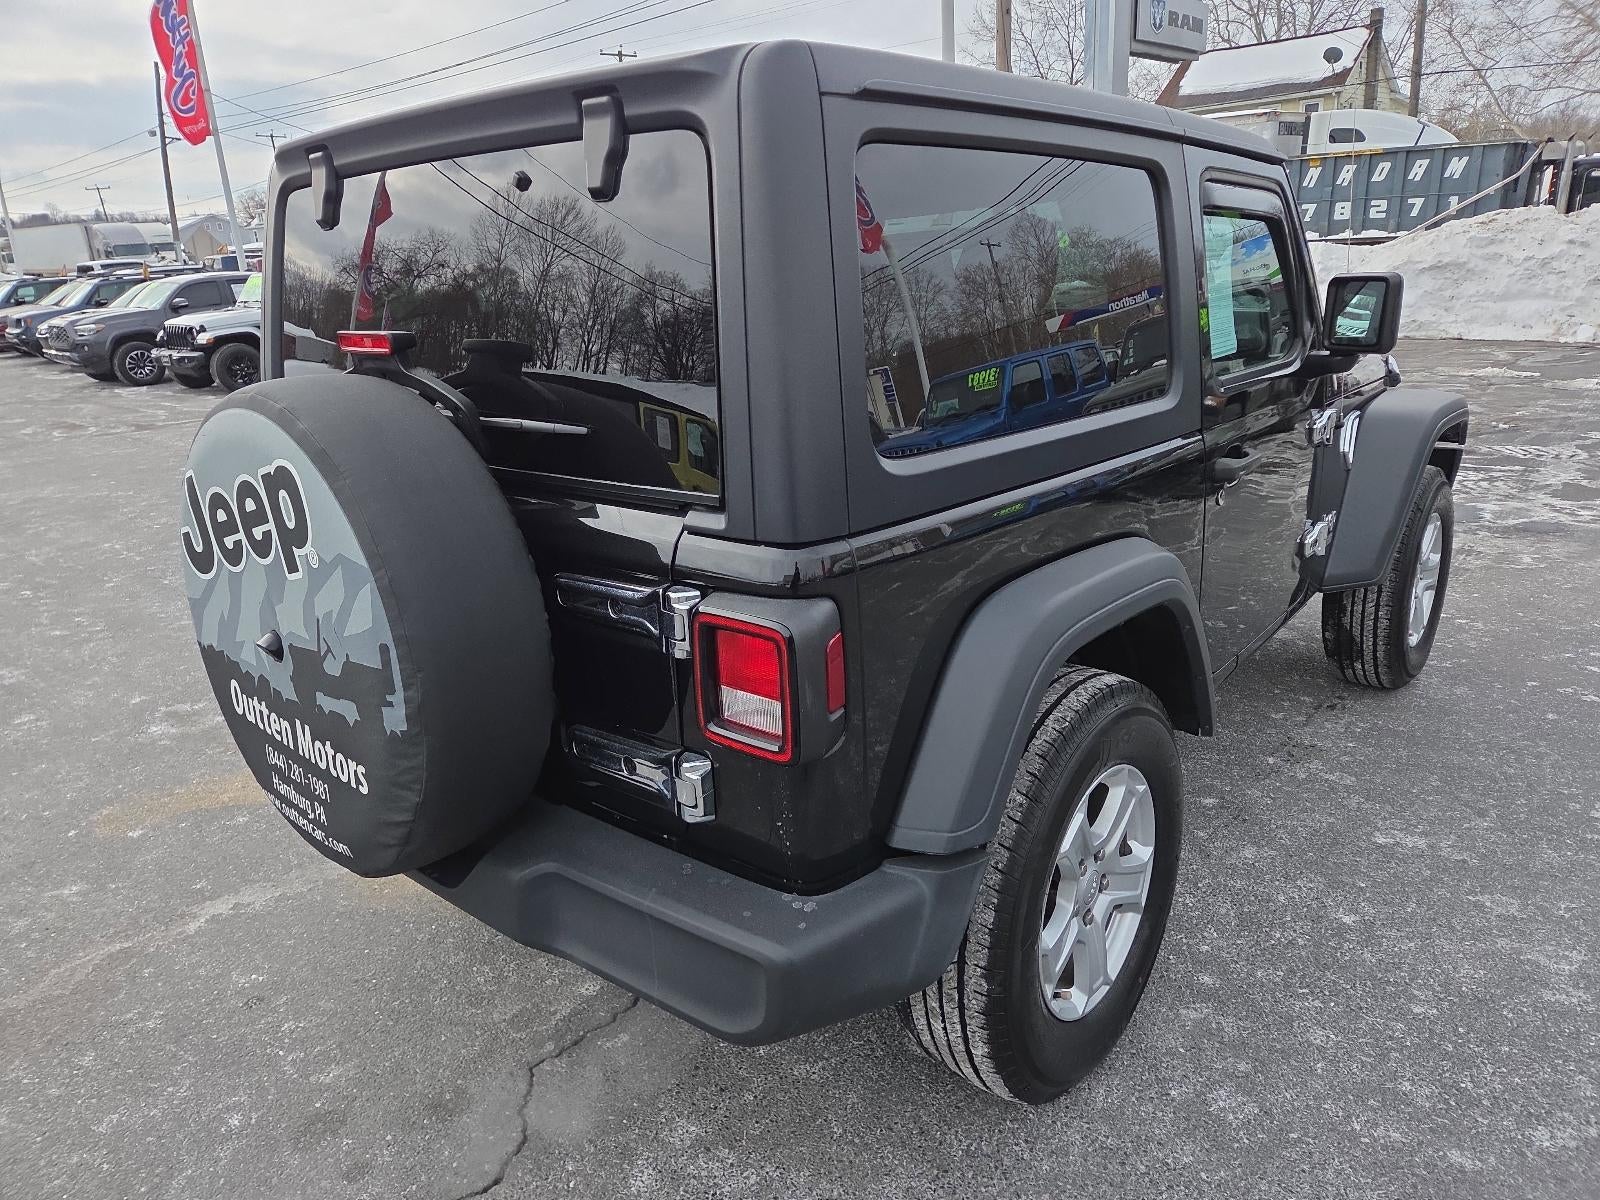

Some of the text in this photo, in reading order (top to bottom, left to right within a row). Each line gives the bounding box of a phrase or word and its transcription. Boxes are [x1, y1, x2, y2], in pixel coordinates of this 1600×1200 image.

[1168, 9, 1204, 35] RAM
[180, 458, 312, 581] Jeep
[230, 678, 369, 795] Outten Motors
[265, 743, 331, 803] (844) 281-1981
[272, 771, 328, 827] Hamburg, PA
